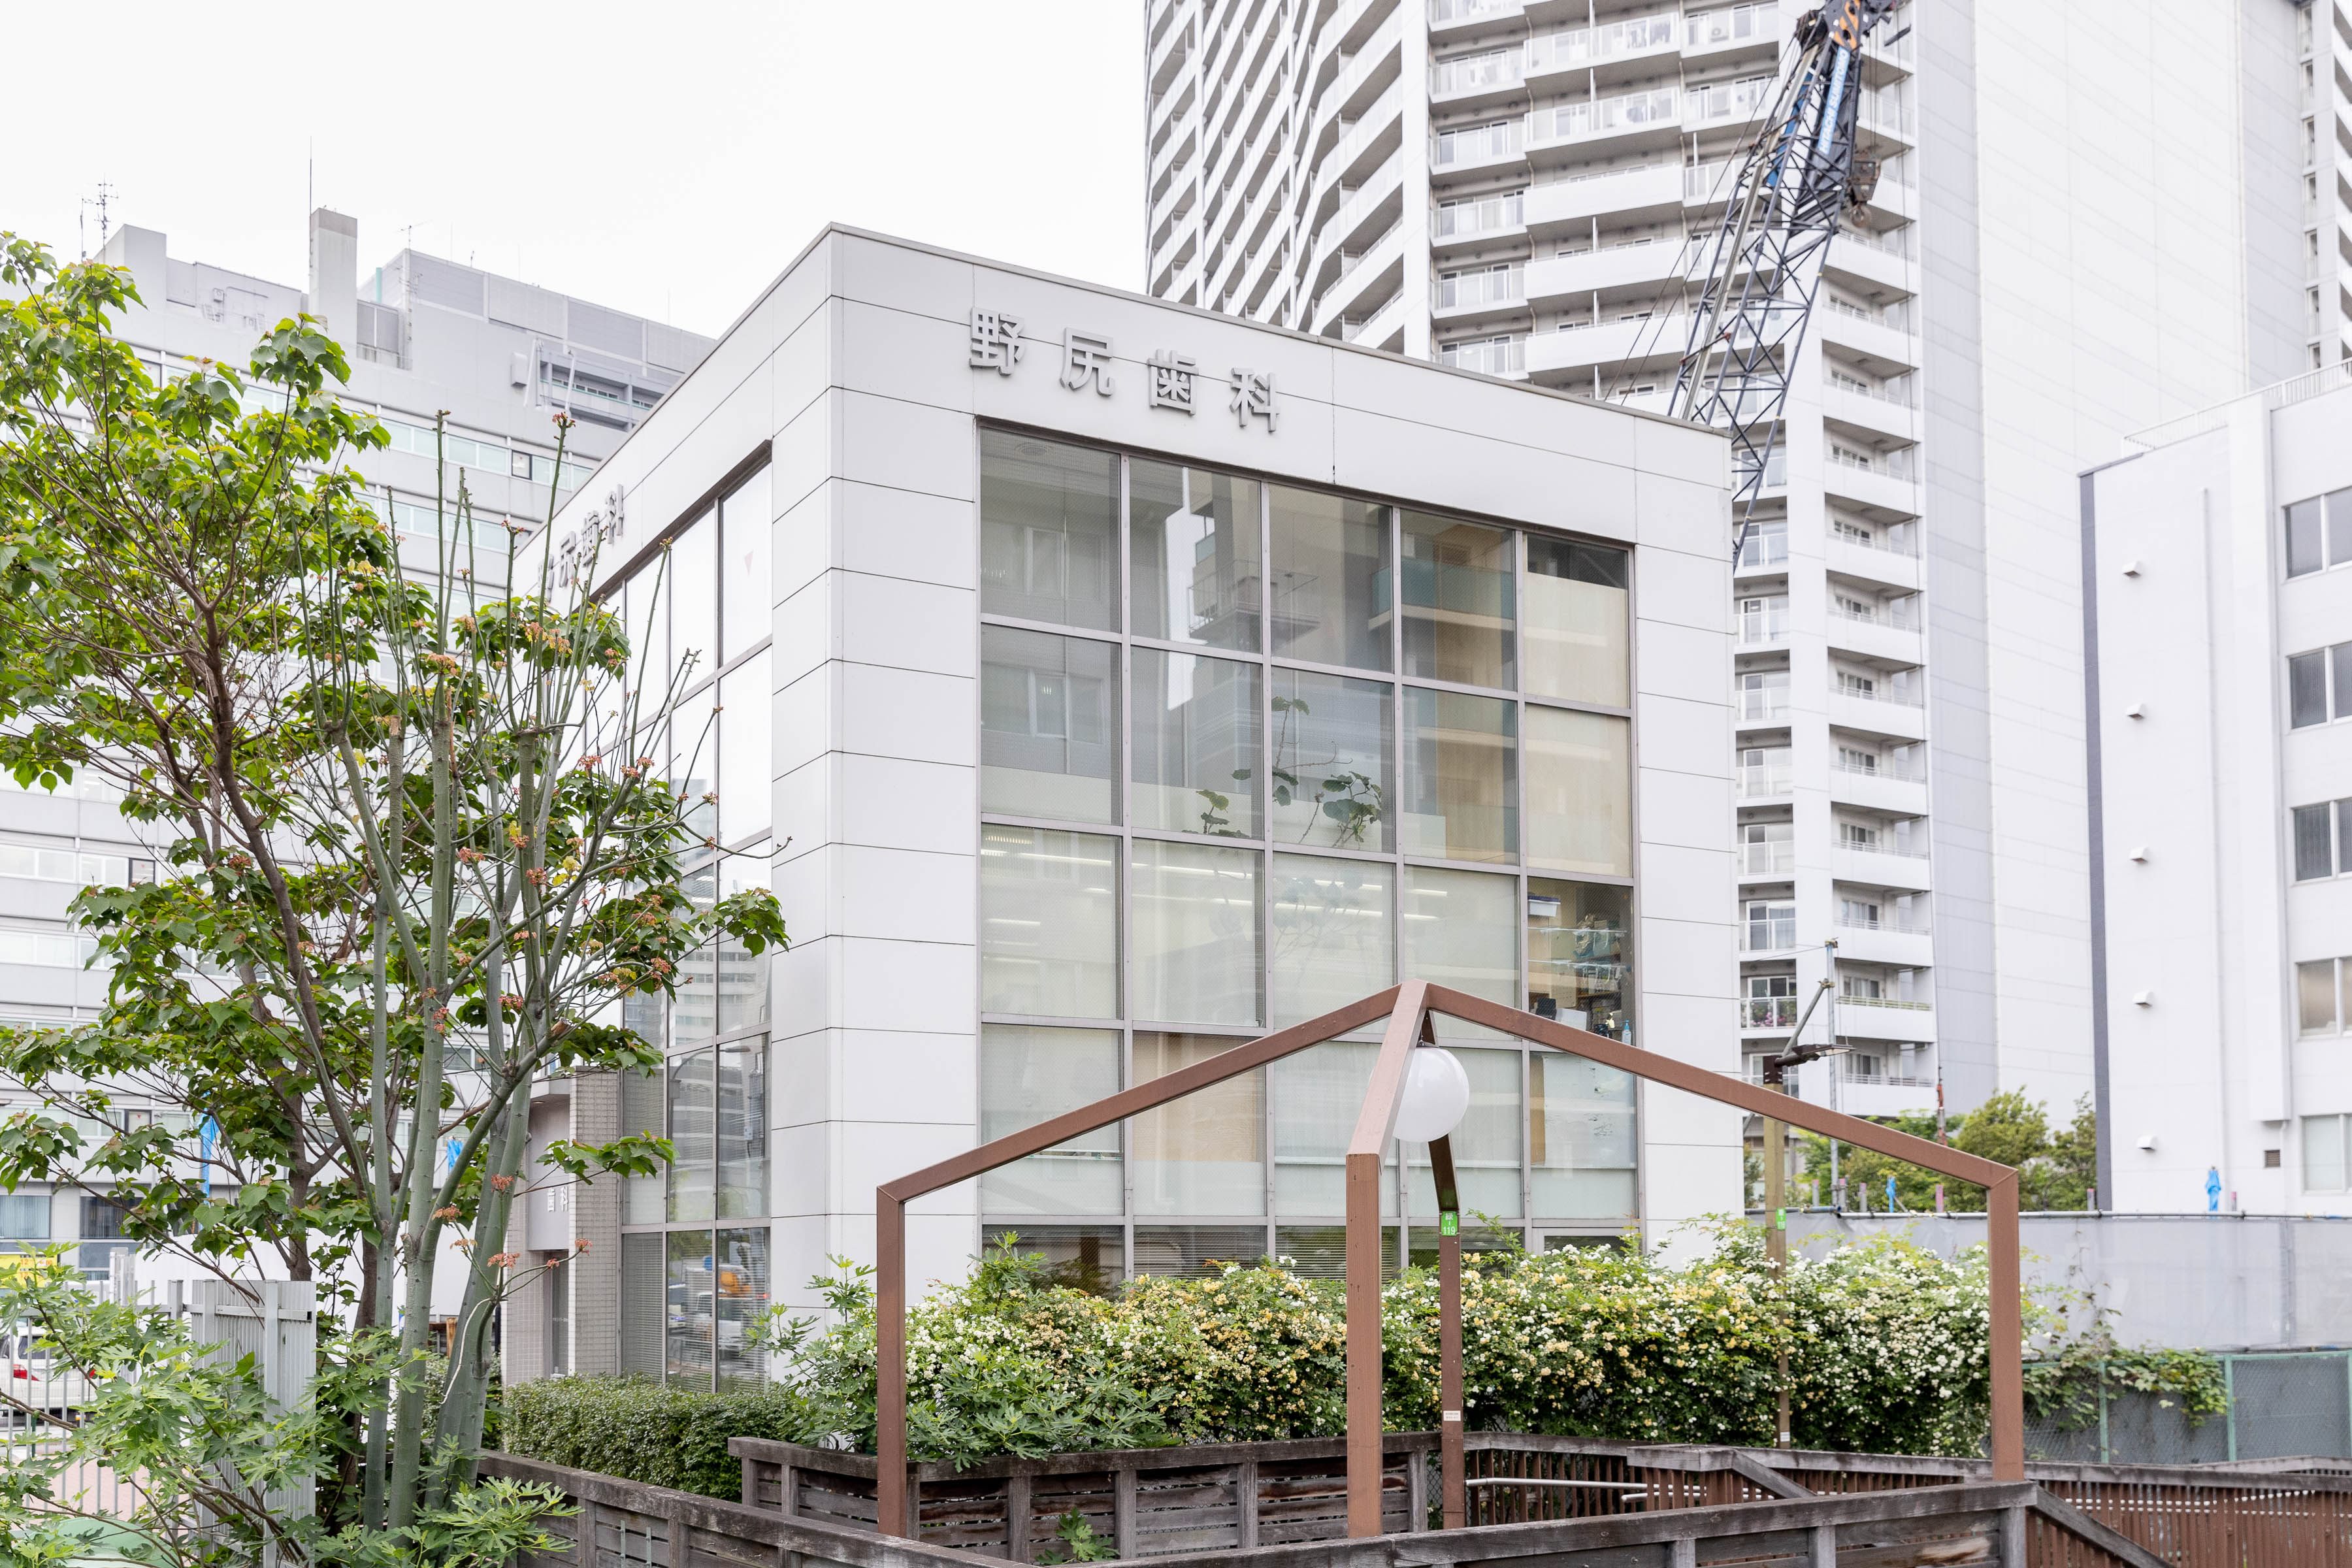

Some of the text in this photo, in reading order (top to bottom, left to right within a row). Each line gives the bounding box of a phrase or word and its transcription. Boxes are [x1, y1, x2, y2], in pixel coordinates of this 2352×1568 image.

[1819, 49, 1848, 154] HITACHI SUMITOMO
[970, 306, 1280, 433] 野尻歯科
